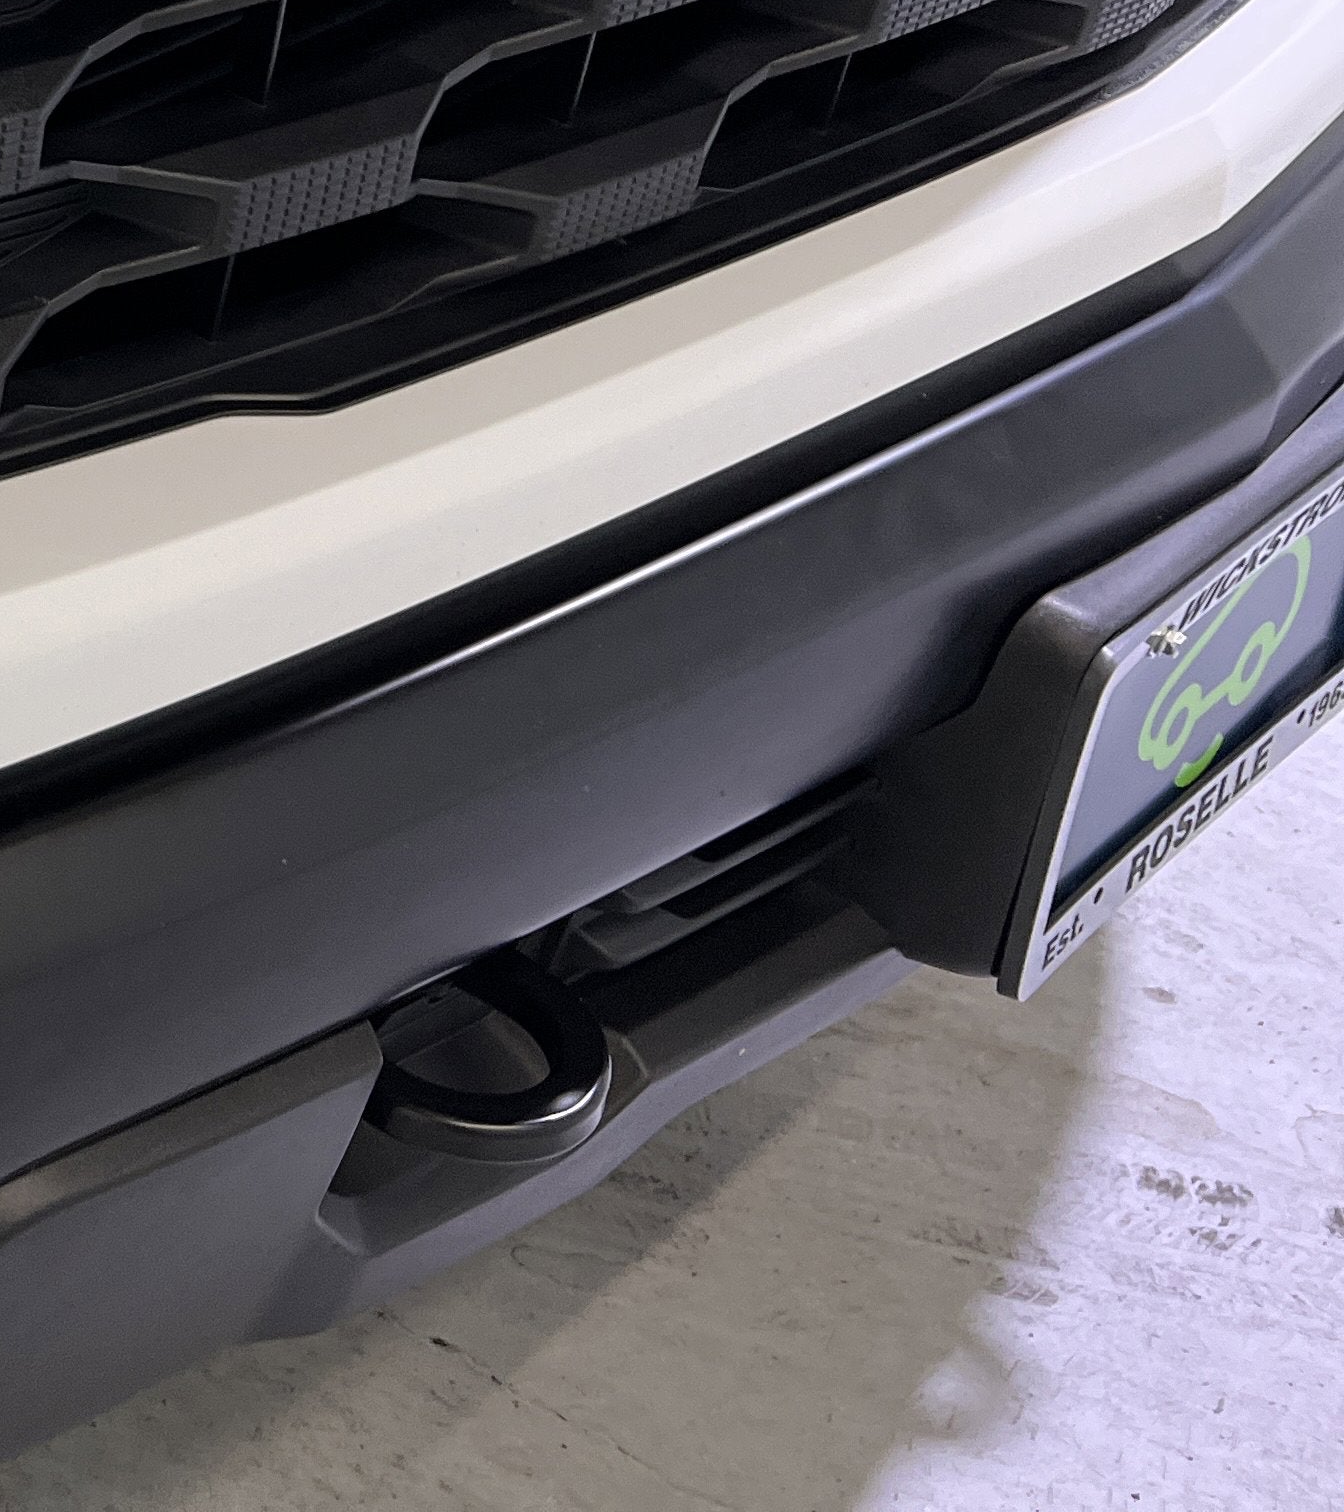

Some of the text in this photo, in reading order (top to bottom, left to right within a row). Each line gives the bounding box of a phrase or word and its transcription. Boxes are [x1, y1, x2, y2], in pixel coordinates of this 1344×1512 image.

[1178, 481, 1344, 631] WICKSTRO
[1042, 680, 1344, 972] Est. ROSELLE 196
